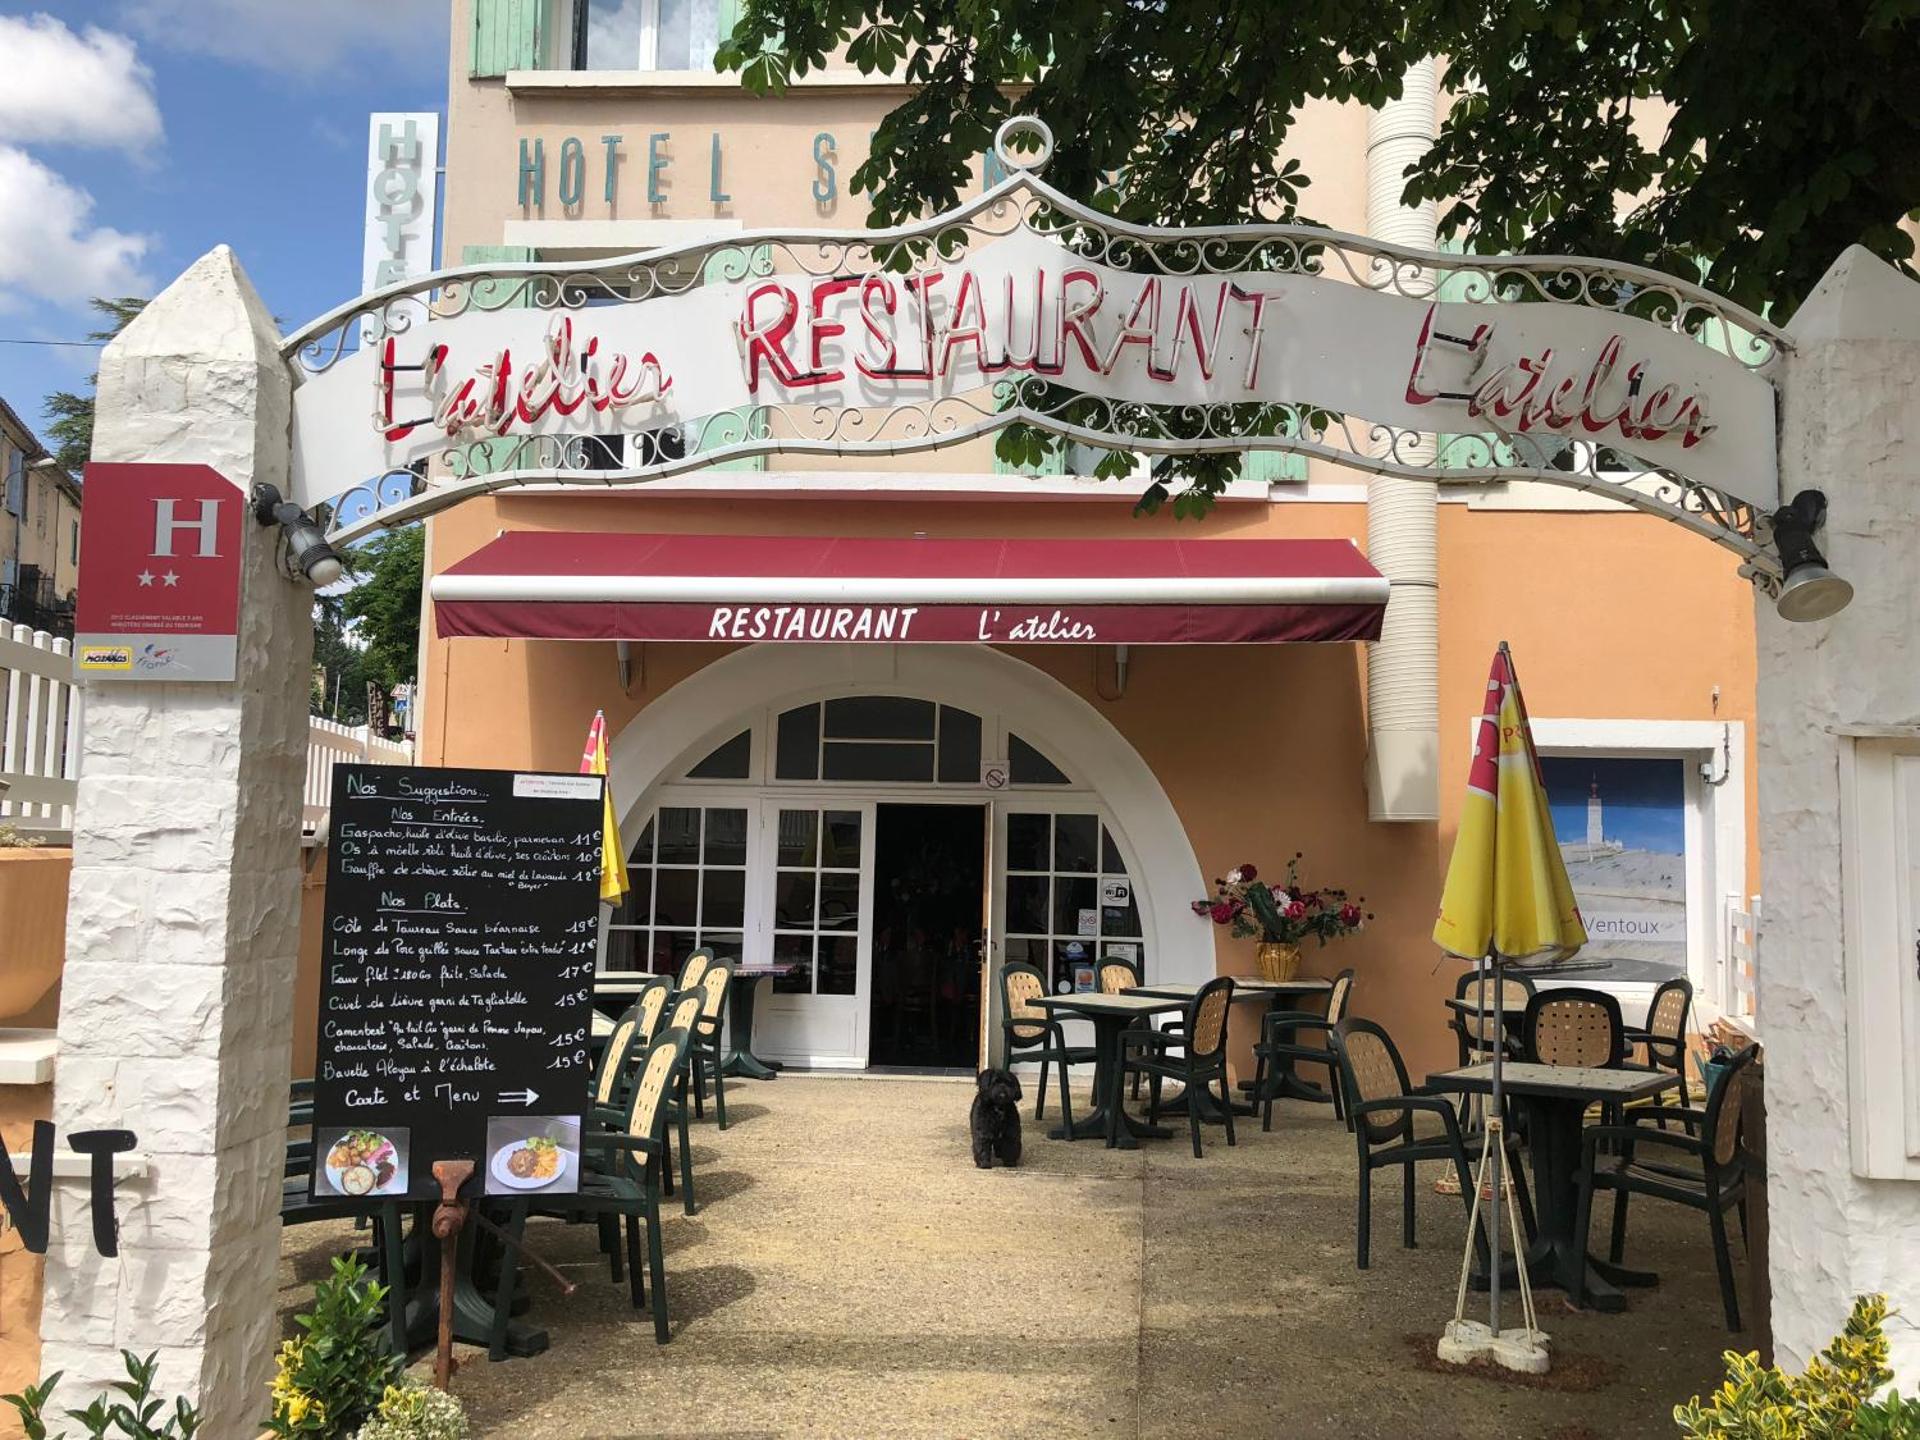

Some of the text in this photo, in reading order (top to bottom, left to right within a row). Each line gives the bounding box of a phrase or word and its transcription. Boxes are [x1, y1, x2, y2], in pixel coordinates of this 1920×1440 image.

[518, 132, 731, 207] HOTEL
[735, 266, 1286, 396] RESTAURANT
[147, 498, 226, 558] H
[709, 607, 918, 639] RESTAURANT
[347, 773, 377, 794] Nos
[391, 806, 413, 819] Nos
[341, 841, 361, 855] Os
[393, 861, 408, 875] de
[498, 870, 515, 879] miel
[381, 890, 406, 907] Nos
[372, 917, 388, 932] de
[391, 919, 440, 934] Taureau
[484, 921, 540, 934] béarnaise
[1583, 917, 1660, 934] Ventoux
[333, 938, 369, 964] Longe
[374, 941, 390, 955] de
[329, 994, 361, 1010] Civet
[366, 994, 384, 1008] de
[429, 998, 456, 1013] garni
[459, 994, 470, 1006] de
[469, 1024, 479, 1033] de
[323, 1060, 369, 1081] Bavette
[421, 1060, 431, 1073] à
[345, 1082, 480, 1111] Carte et Menu
